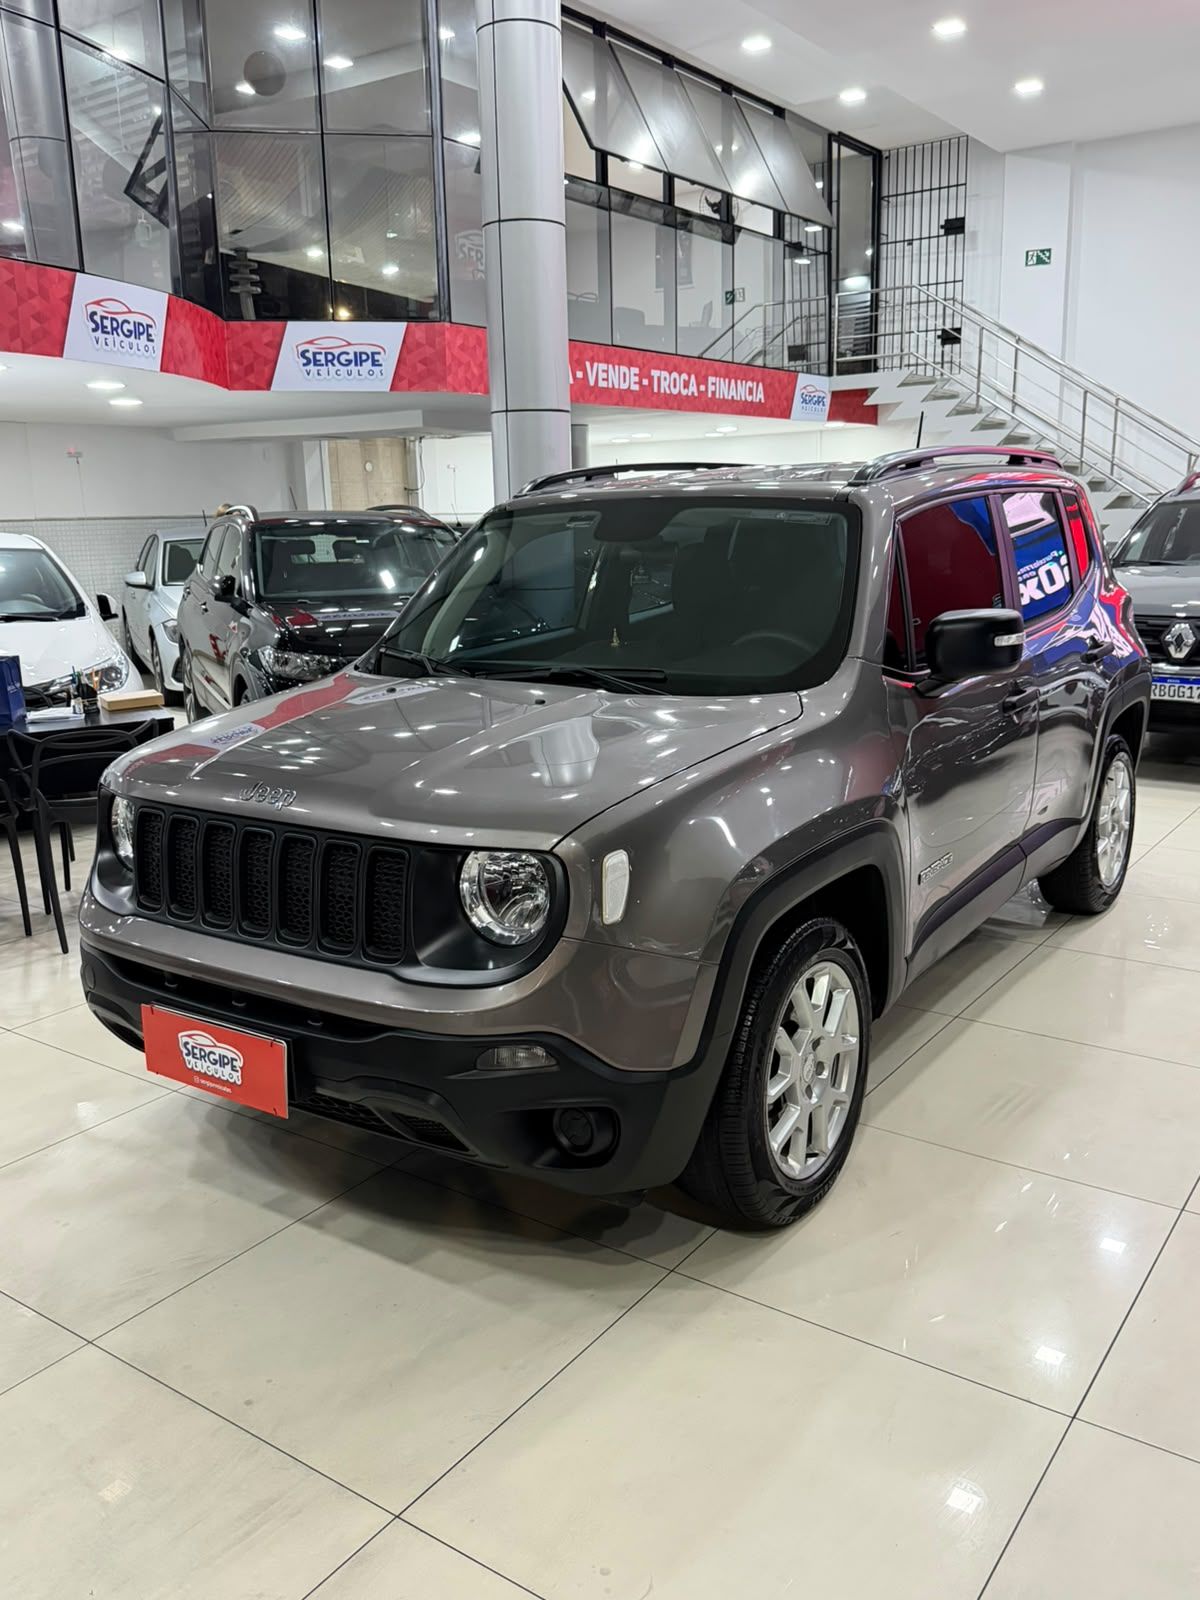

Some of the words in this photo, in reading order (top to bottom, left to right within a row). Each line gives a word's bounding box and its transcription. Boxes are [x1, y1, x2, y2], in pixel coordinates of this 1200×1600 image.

[89, 311, 155, 343] SERGIPE
[300, 349, 383, 367] SERGIPE
[305, 367, 384, 377] VEÍCULOS
[585, 360, 640, 391] VENDE
[651, 369, 698, 397] TROCA
[707, 376, 765, 403] FINANCIA
[239, 781, 297, 811] Jeep
[183, 1041, 239, 1073] SERGIPE
